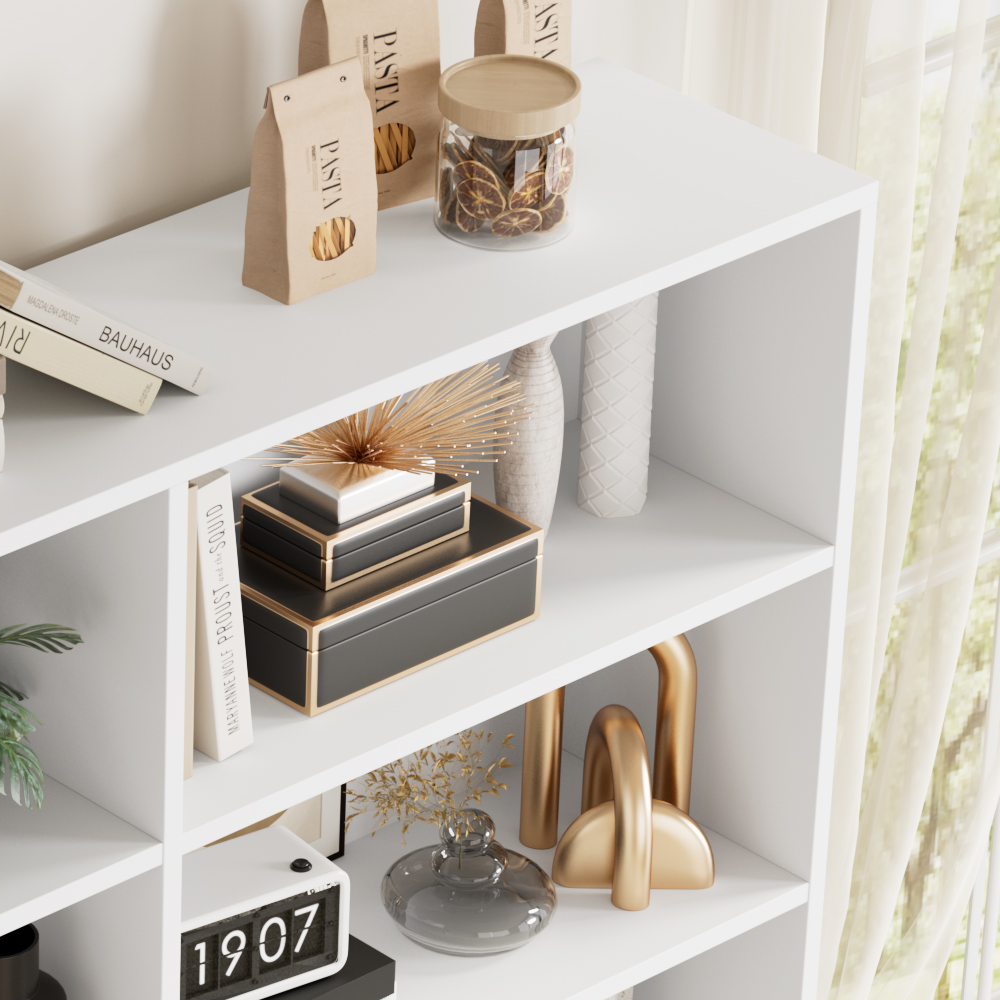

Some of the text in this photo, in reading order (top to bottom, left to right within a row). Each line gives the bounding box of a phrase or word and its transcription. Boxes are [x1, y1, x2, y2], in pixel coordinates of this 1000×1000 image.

[534, 0, 559, 58] ASTA
[373, 27, 400, 115] PASTA
[320, 136, 343, 212] PASTA
[27, 295, 80, 326] MAGDALENA DROSTE
[98, 326, 174, 371] BAUHAUS
[206, 504, 226, 555] SQUID
[212, 583, 234, 646] PROUST
